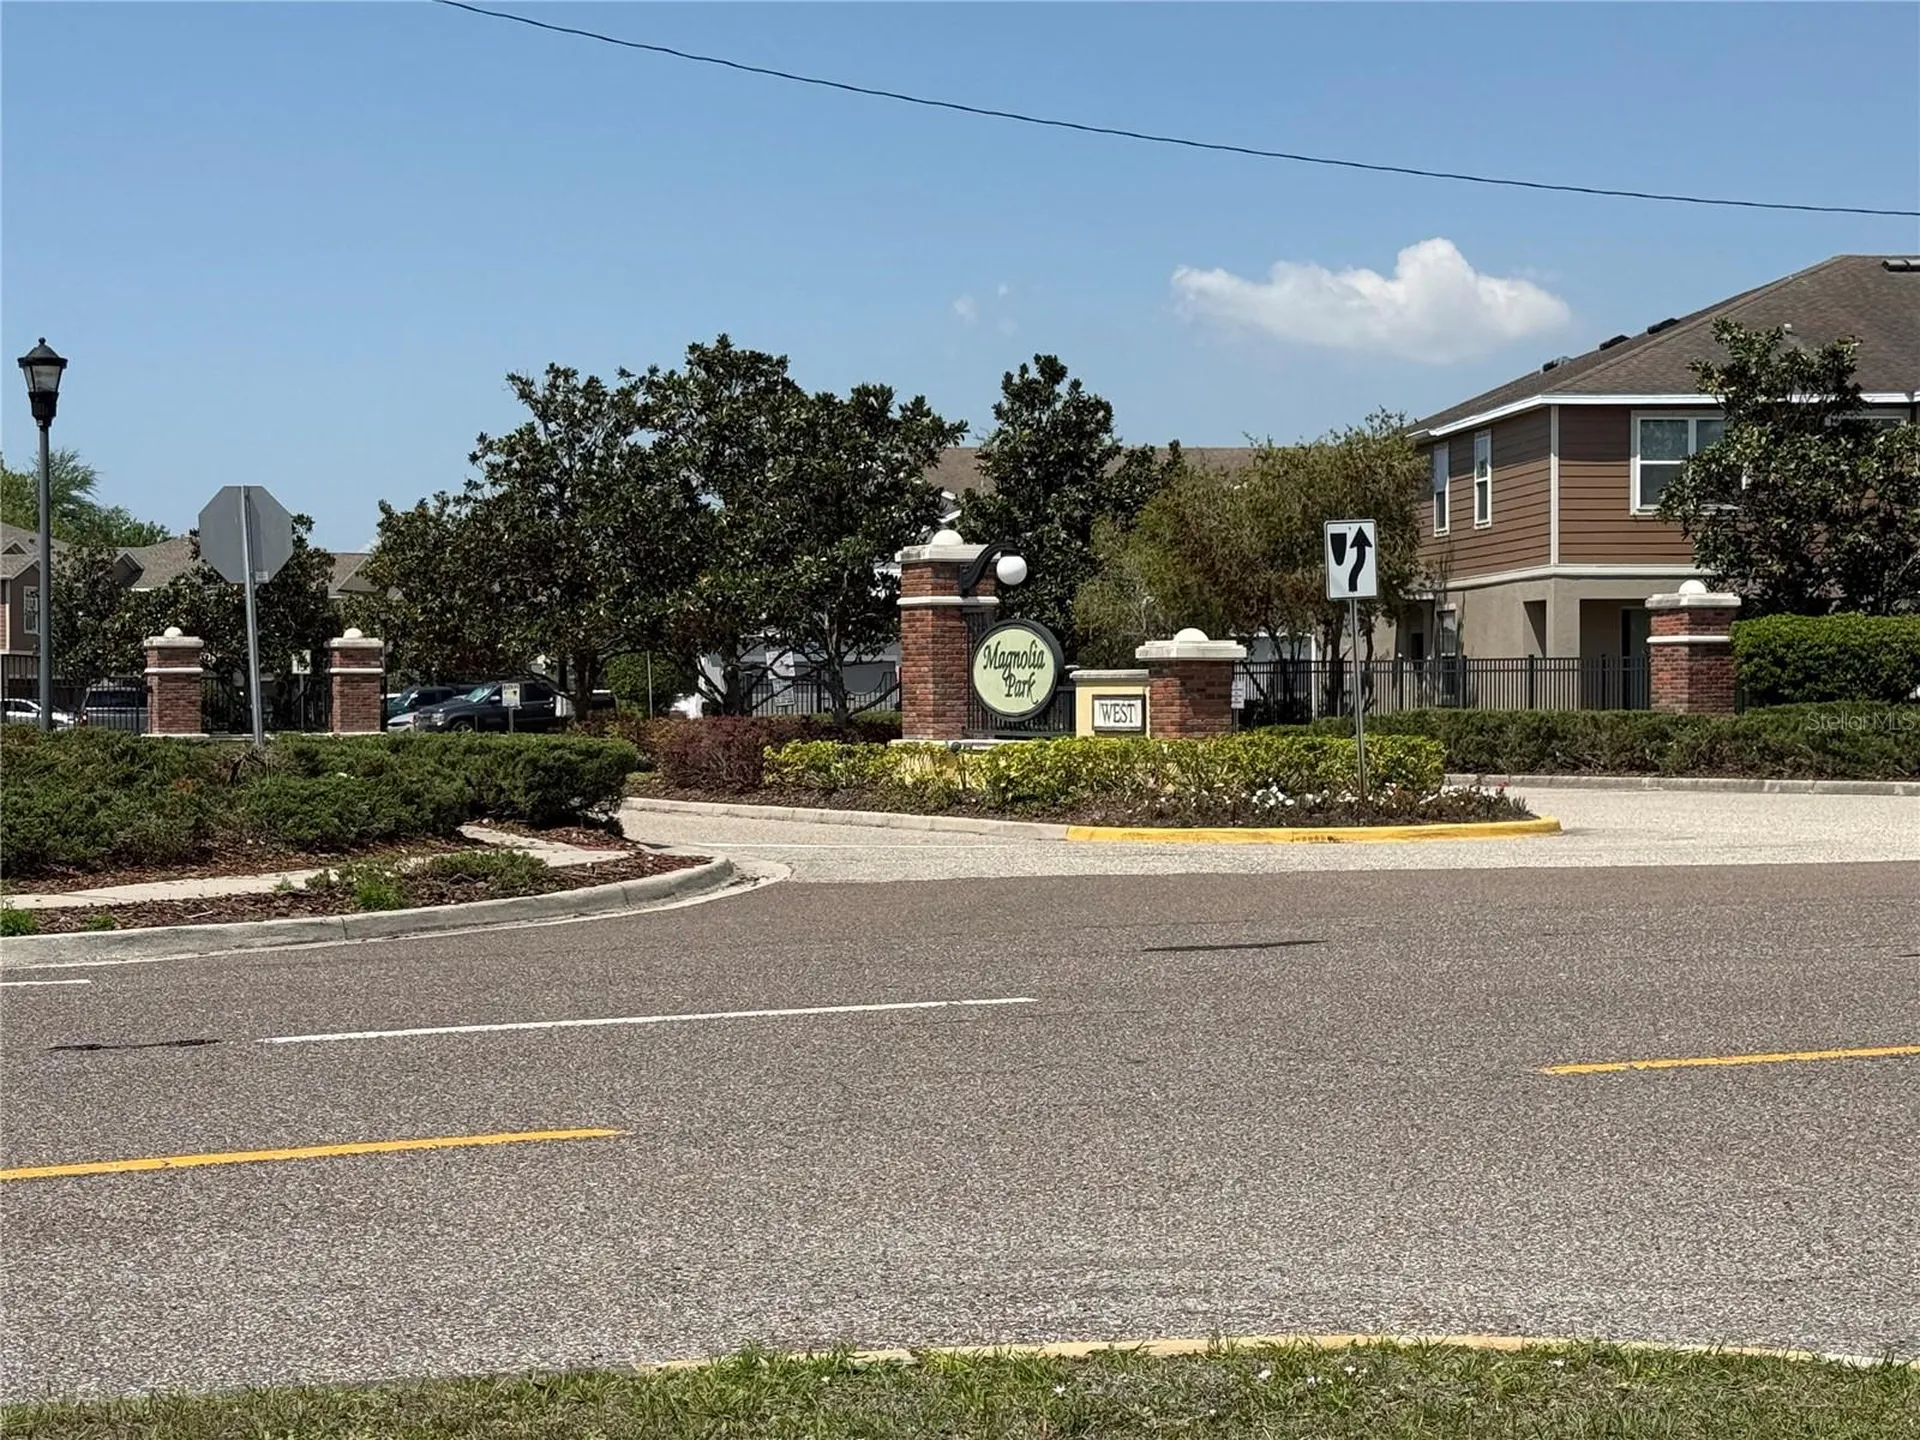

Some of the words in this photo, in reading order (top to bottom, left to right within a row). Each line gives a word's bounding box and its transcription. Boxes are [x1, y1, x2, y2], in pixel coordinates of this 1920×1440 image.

[983, 640, 1045, 680] Magnolia
[1004, 672, 1038, 704] Park
[1100, 703, 1135, 724] WEST
